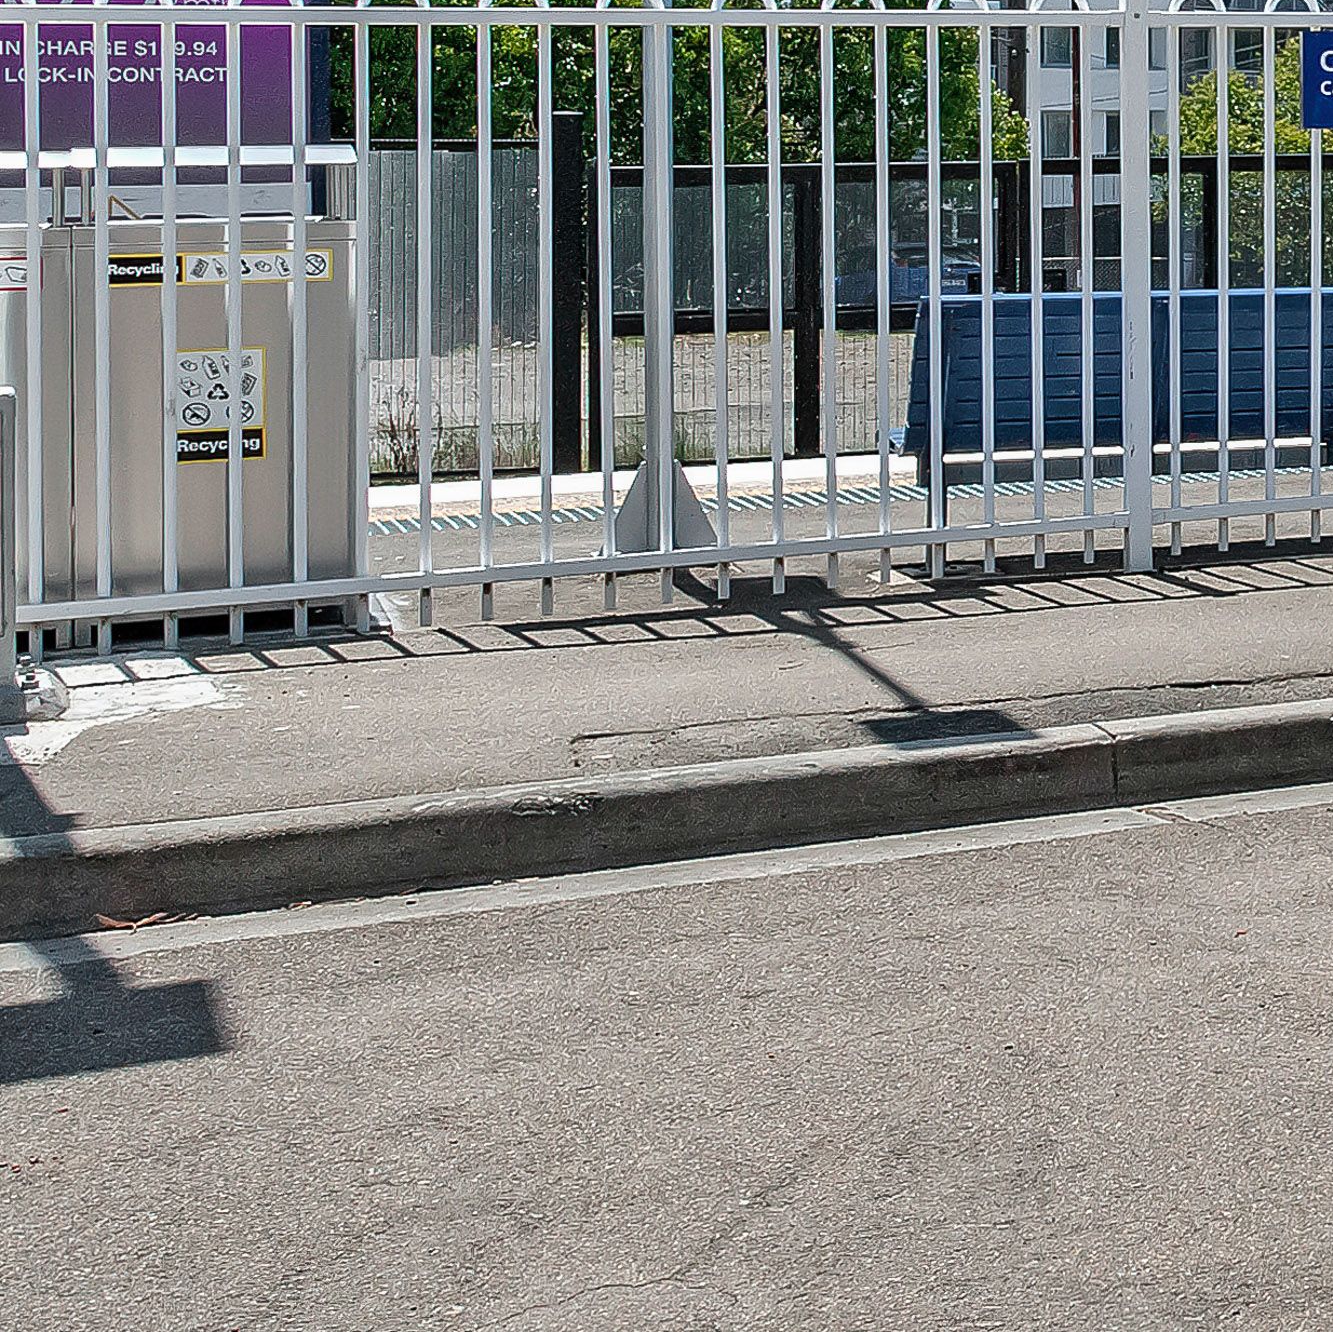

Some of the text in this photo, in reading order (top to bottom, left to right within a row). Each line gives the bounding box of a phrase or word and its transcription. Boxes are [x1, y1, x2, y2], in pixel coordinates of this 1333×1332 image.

[134, 39, 218, 57] $19.94
[108, 262, 179, 277] Recycli
[177, 438, 260, 453] Recycng
